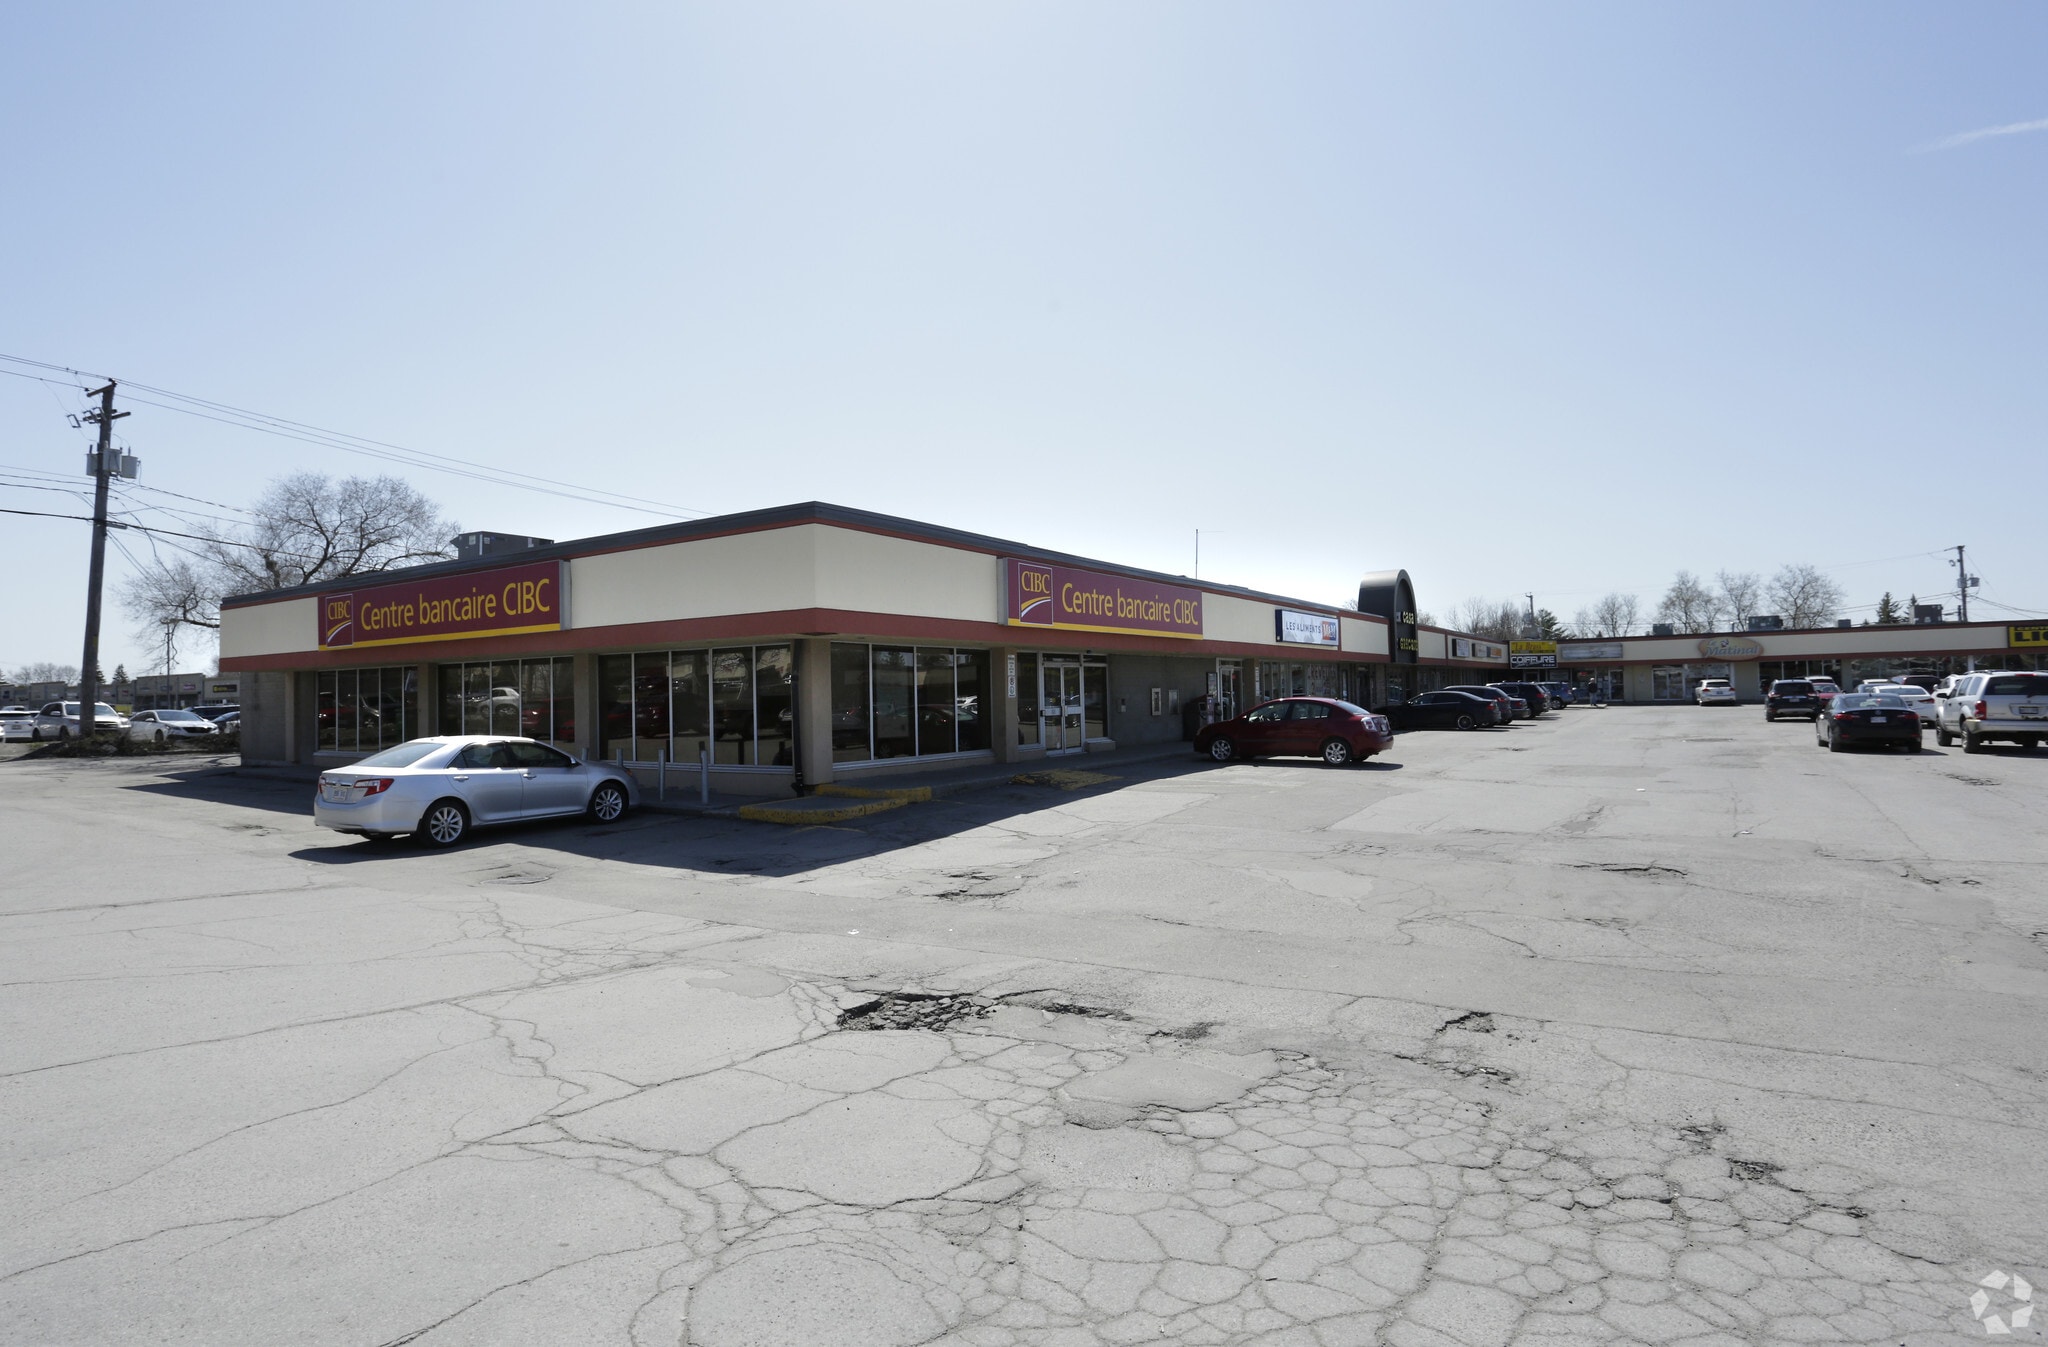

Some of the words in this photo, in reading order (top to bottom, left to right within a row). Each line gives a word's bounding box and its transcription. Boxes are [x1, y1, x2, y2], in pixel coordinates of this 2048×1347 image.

[1021, 571, 1050, 594] CIBC
[327, 600, 351, 620] CIBC
[361, 602, 414, 631] Centre
[419, 587, 497, 625] bancaire
[503, 578, 550, 616] CIBC
[1062, 582, 1113, 617] Centre
[1117, 587, 1171, 622] bancaire
[1173, 598, 1199, 626] CIBC
[1285, 621, 1296, 631] LES
[1297, 622, 1321, 634] ALIMENTS
[1510, 655, 1555, 664] COIFFURE
